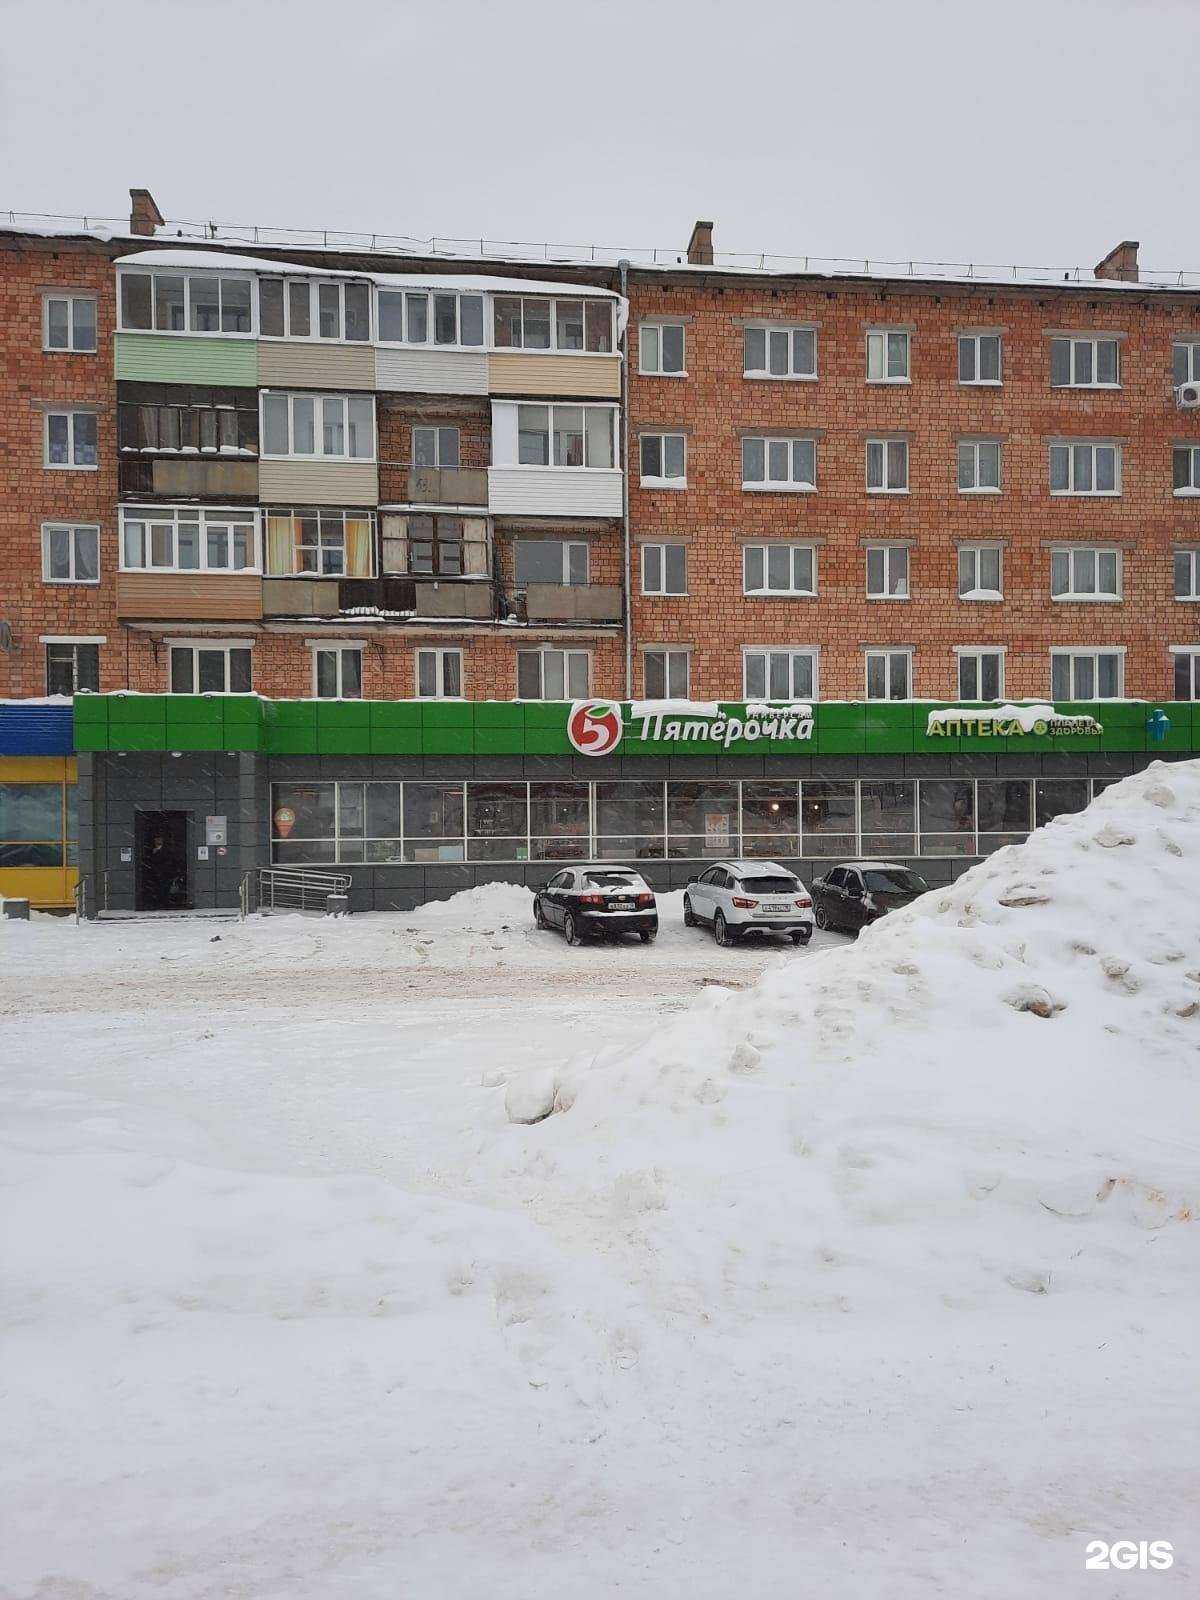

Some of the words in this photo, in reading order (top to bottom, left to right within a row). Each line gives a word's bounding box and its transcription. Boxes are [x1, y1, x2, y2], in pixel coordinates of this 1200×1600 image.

[640, 711, 814, 747] Пятёрочка
[927, 719, 1024, 737] АПТЕКА
[1050, 719, 1097, 727] ПЛАНЕТА
[1049, 727, 1104, 736] ЗДОРОВЬЯ
